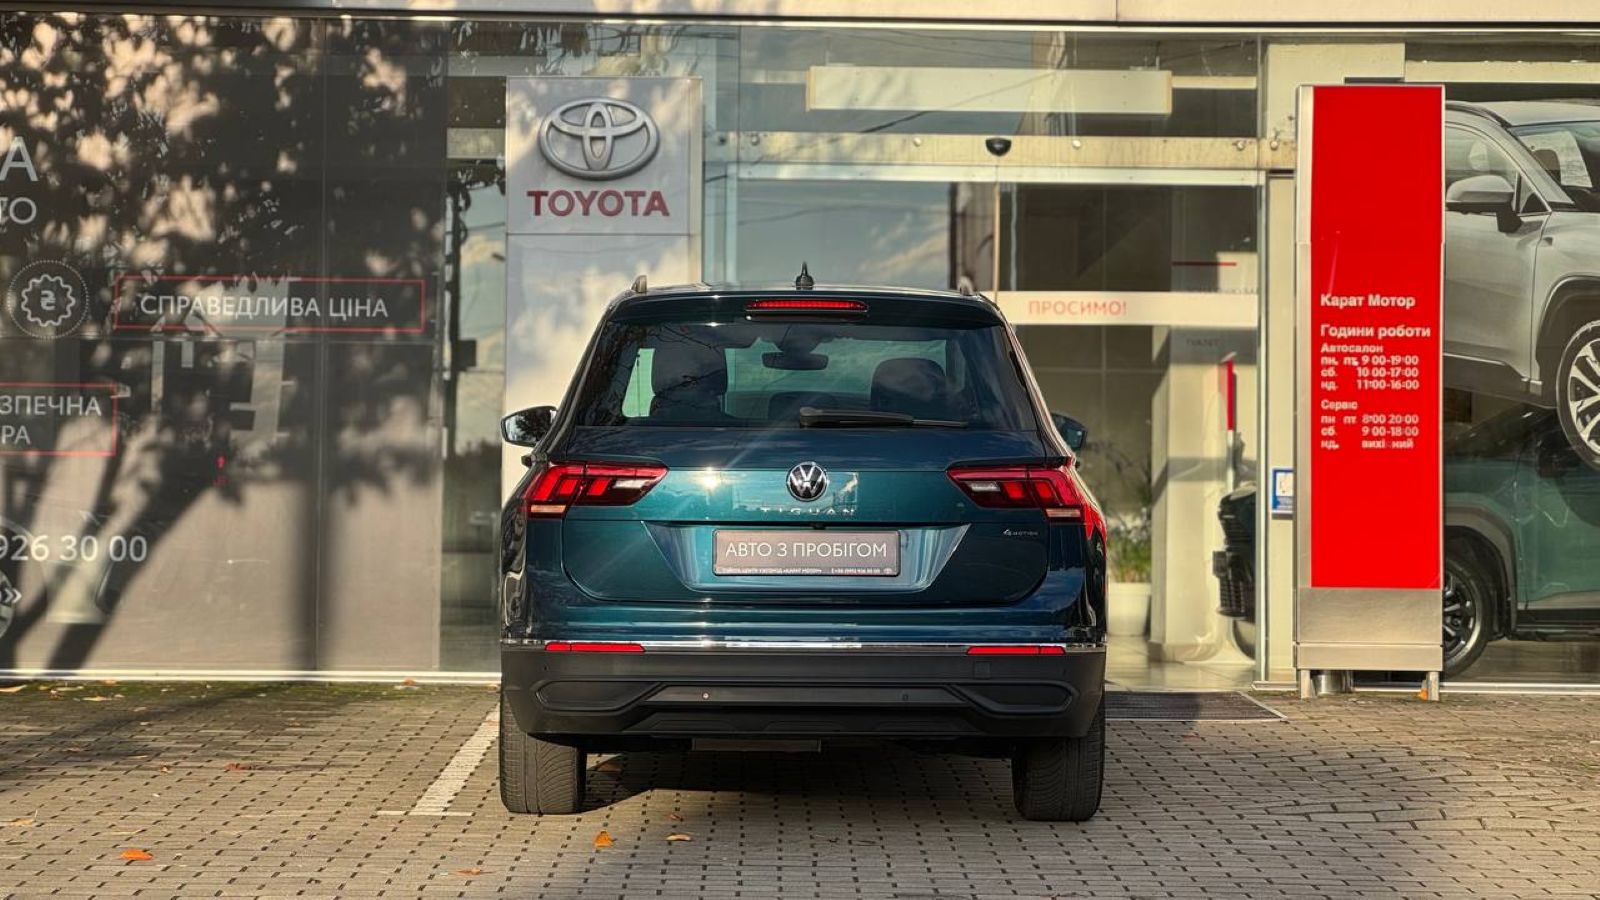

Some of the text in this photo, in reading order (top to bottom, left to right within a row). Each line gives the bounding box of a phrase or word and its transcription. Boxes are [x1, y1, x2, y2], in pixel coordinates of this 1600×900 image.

[527, 190, 670, 217] TOYOTA
[140, 295, 389, 321] СПРАВЕДЛИВА ЦІНА
[1028, 300, 1127, 316] ПРОСИМО!
[1320, 293, 1416, 309] Карат Мотор
[1320, 324, 1431, 339] Години роботи
[1320, 343, 1384, 353] Автосалон
[59, 535, 98, 561] 30
[109, 535, 147, 561] 00
[725, 542, 772, 558] АВТО
[793, 542, 887, 558] ПРОБІГОМ
